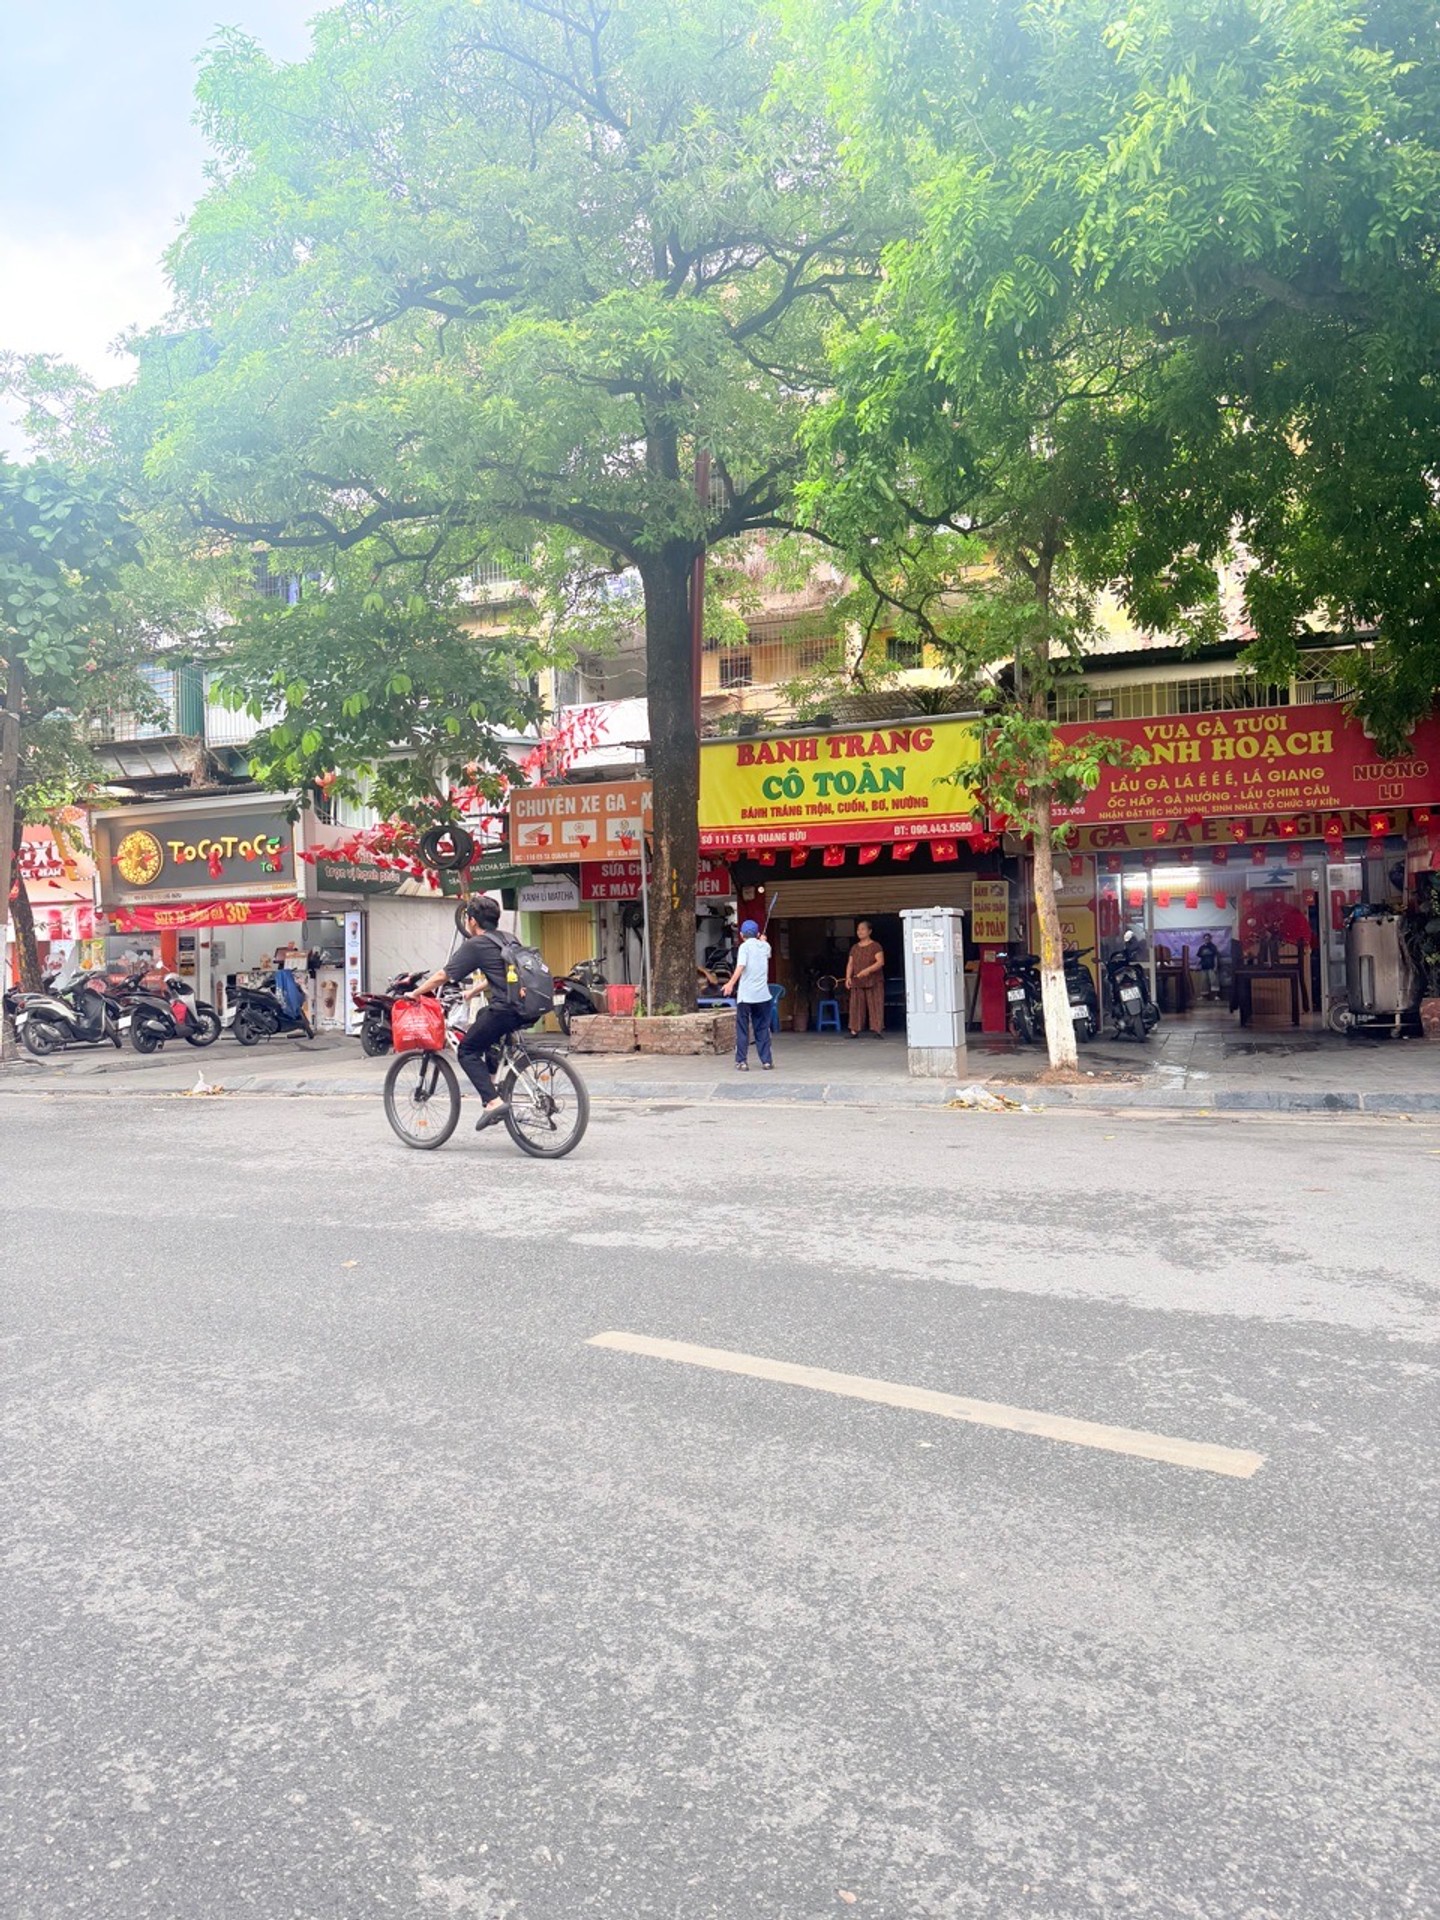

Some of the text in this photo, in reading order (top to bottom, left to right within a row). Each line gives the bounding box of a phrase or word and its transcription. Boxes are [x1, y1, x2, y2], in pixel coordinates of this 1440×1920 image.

[1143, 715, 1288, 740] VUA GÀ TƯƠI
[736, 727, 934, 767] BÁNH TRÁNG
[1211, 730, 1334, 763] HOẠCH
[762, 761, 906, 800] CÔ TOÀN
[1144, 775, 1169, 791] GÀ
[1175, 773, 1194, 788] LÁ
[1243, 768, 1262, 784] LÁ
[1267, 766, 1325, 782] GIANG
[1163, 792, 1182, 804] GÀ
[1266, 787, 1299, 798] CHIM
[1378, 783, 1404, 800] LU
[516, 794, 576, 818] CHUYÊN
[580, 794, 600, 814] XE
[605, 793, 626, 812] GA
[741, 804, 768, 819] BÁNH
[770, 803, 803, 818] TRÁNG
[757, 832, 787, 844] QUANG
[601, 860, 625, 877] SỬA
[591, 884, 606, 897] XE
[610, 880, 636, 896] MÁY
